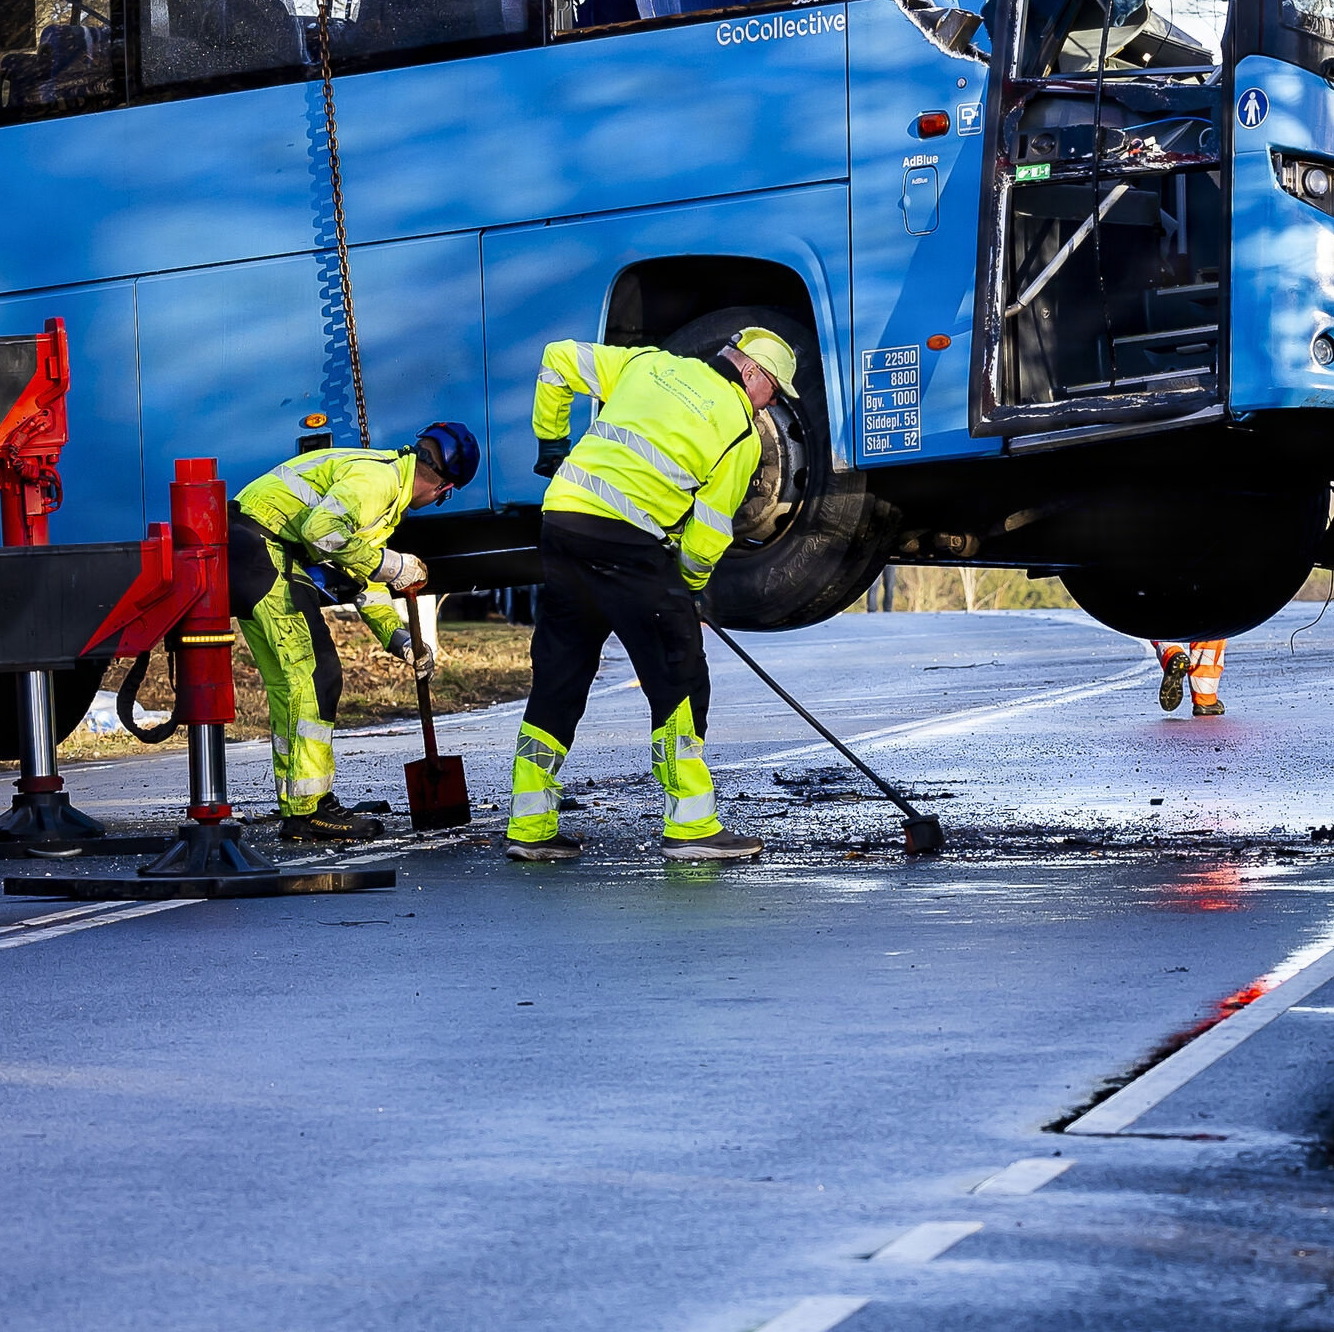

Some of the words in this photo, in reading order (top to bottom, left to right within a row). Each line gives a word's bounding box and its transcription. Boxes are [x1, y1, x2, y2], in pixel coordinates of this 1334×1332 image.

[717, 11, 845, 46] GoCollective
[902, 154, 939, 168] AdBlue
[865, 355, 874, 368] T.
[884, 350, 917, 367] 22500
[865, 375, 875, 388] L.
[890, 370, 917, 386] 8800
[866, 395, 885, 411] Bgv.
[891, 390, 917, 406] 1000
[866, 413, 903, 430] Siddepl.
[904, 411, 917, 426] 55
[866, 435, 893, 452] Ståpl.
[904, 431, 918, 446] 52
